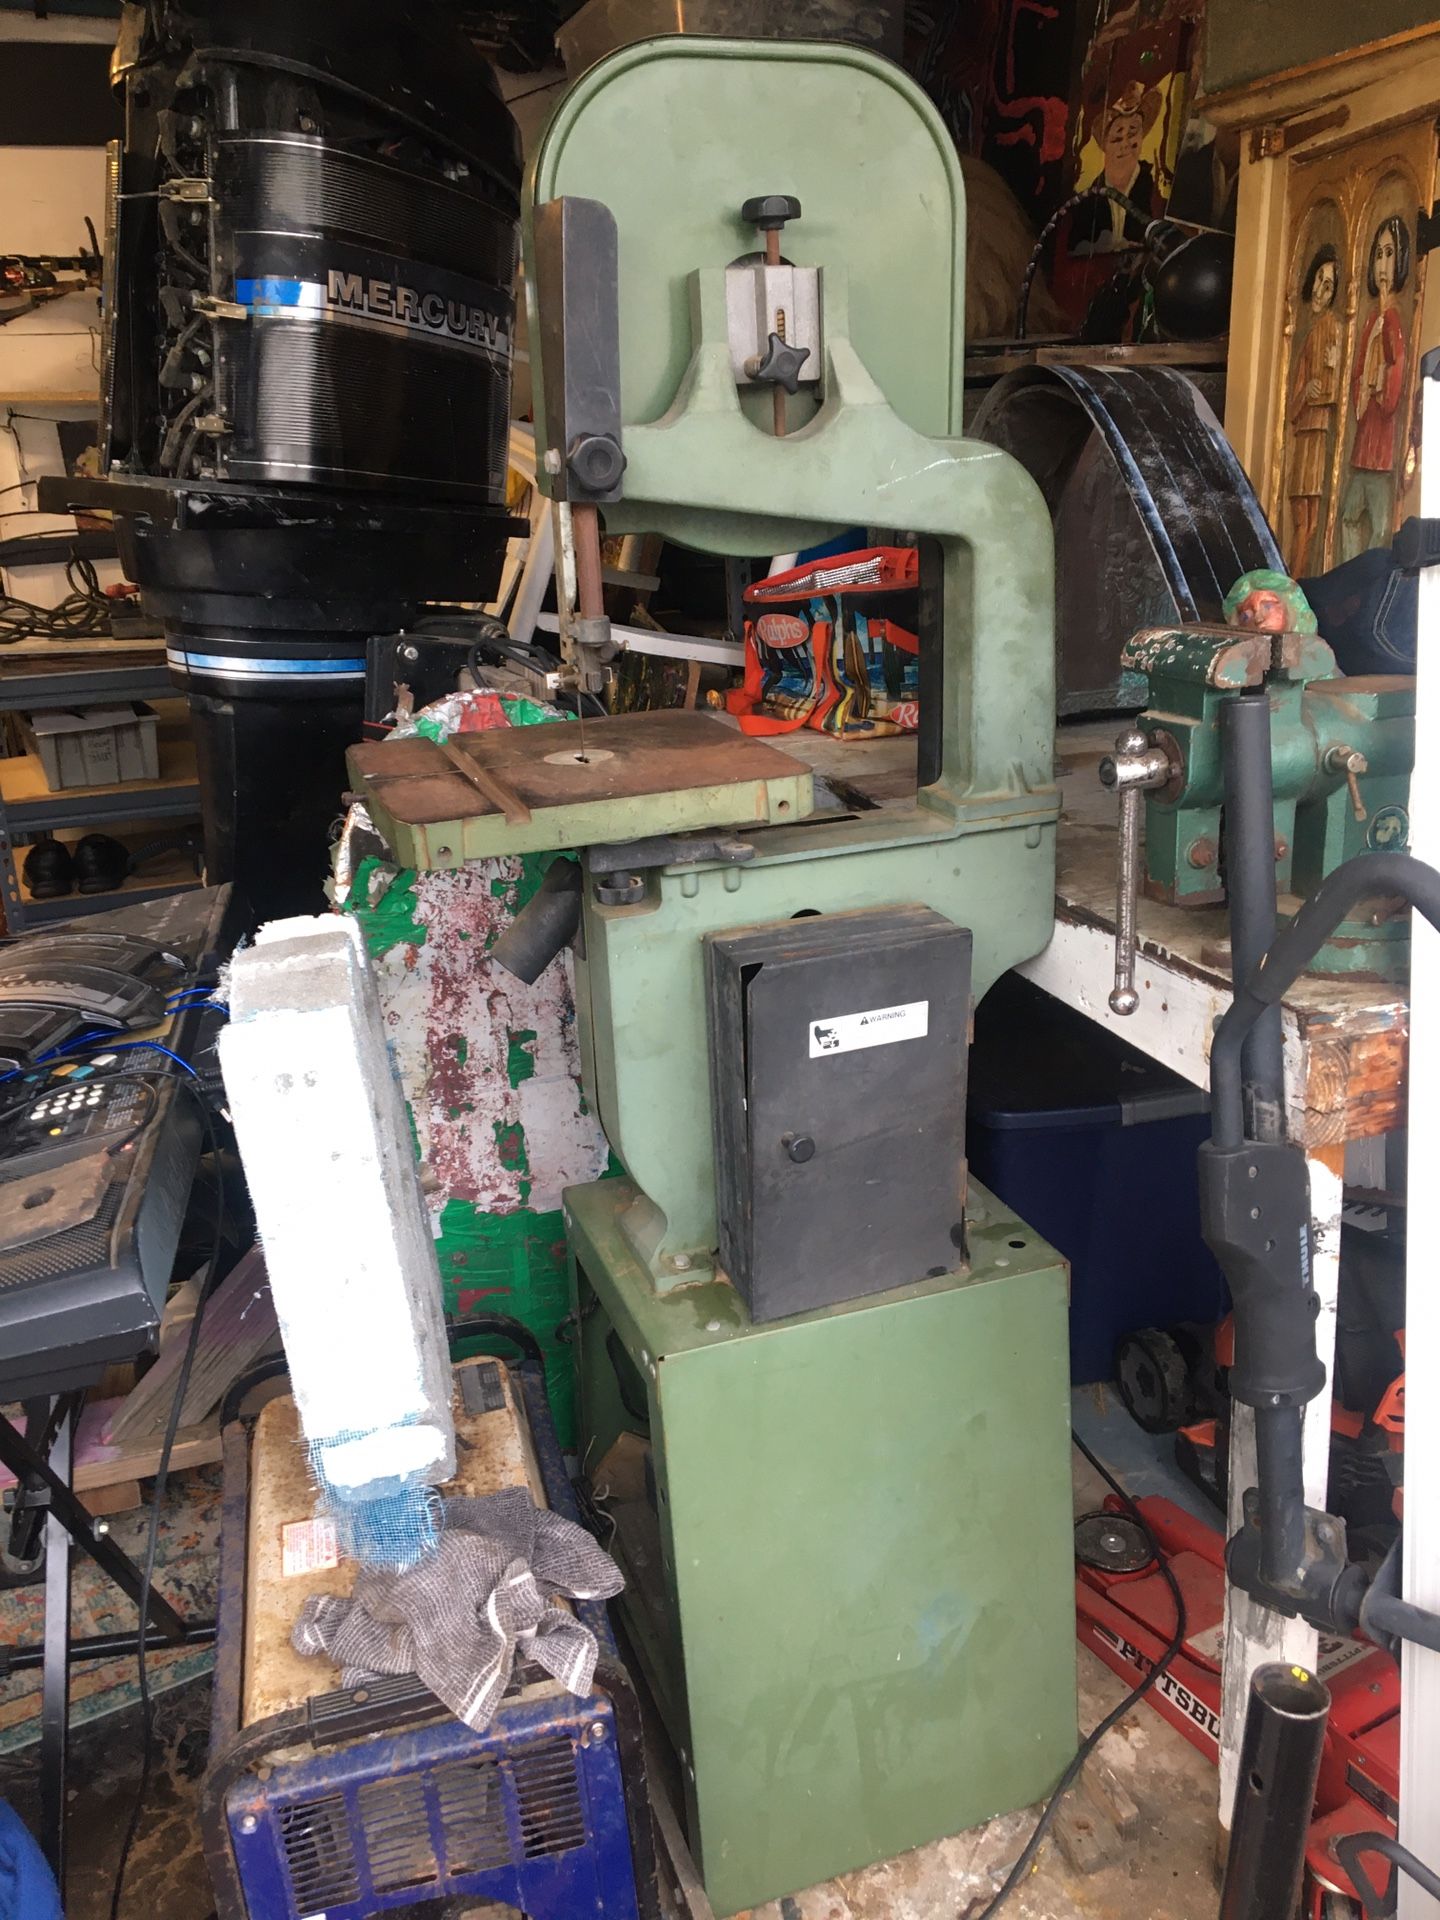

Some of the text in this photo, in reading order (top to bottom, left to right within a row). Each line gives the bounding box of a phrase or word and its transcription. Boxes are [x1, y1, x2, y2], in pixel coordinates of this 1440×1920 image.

[327, 269, 498, 346] MERCURY
[758, 618, 803, 645] Ralphs
[869, 1009, 906, 1024] WARNING
